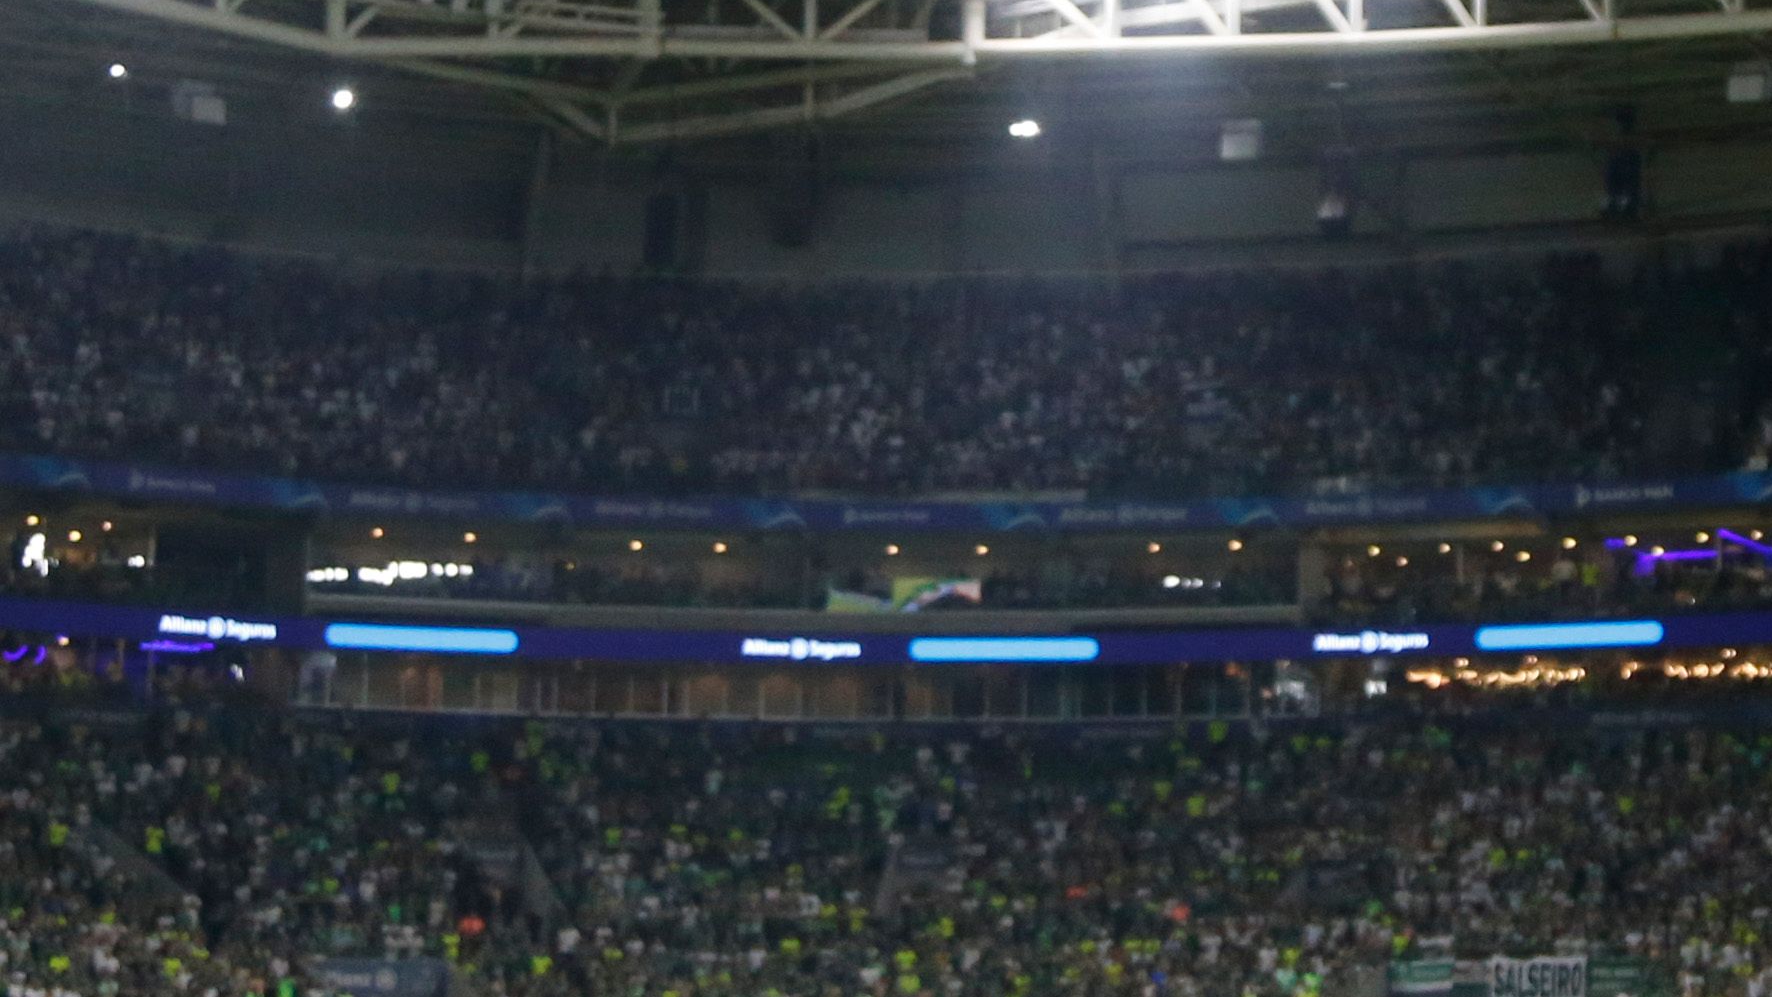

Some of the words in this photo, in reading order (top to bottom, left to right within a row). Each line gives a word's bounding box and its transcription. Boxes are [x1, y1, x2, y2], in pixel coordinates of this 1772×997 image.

[158, 614, 208, 635] Allianz
[224, 617, 277, 641] Seguros
[740, 637, 791, 657] Allianz
[808, 638, 862, 661] Seguros
[1312, 632, 1361, 652] Allianz
[1377, 630, 1429, 654] Seguros
[1492, 962, 1584, 997] SALSEIRO
